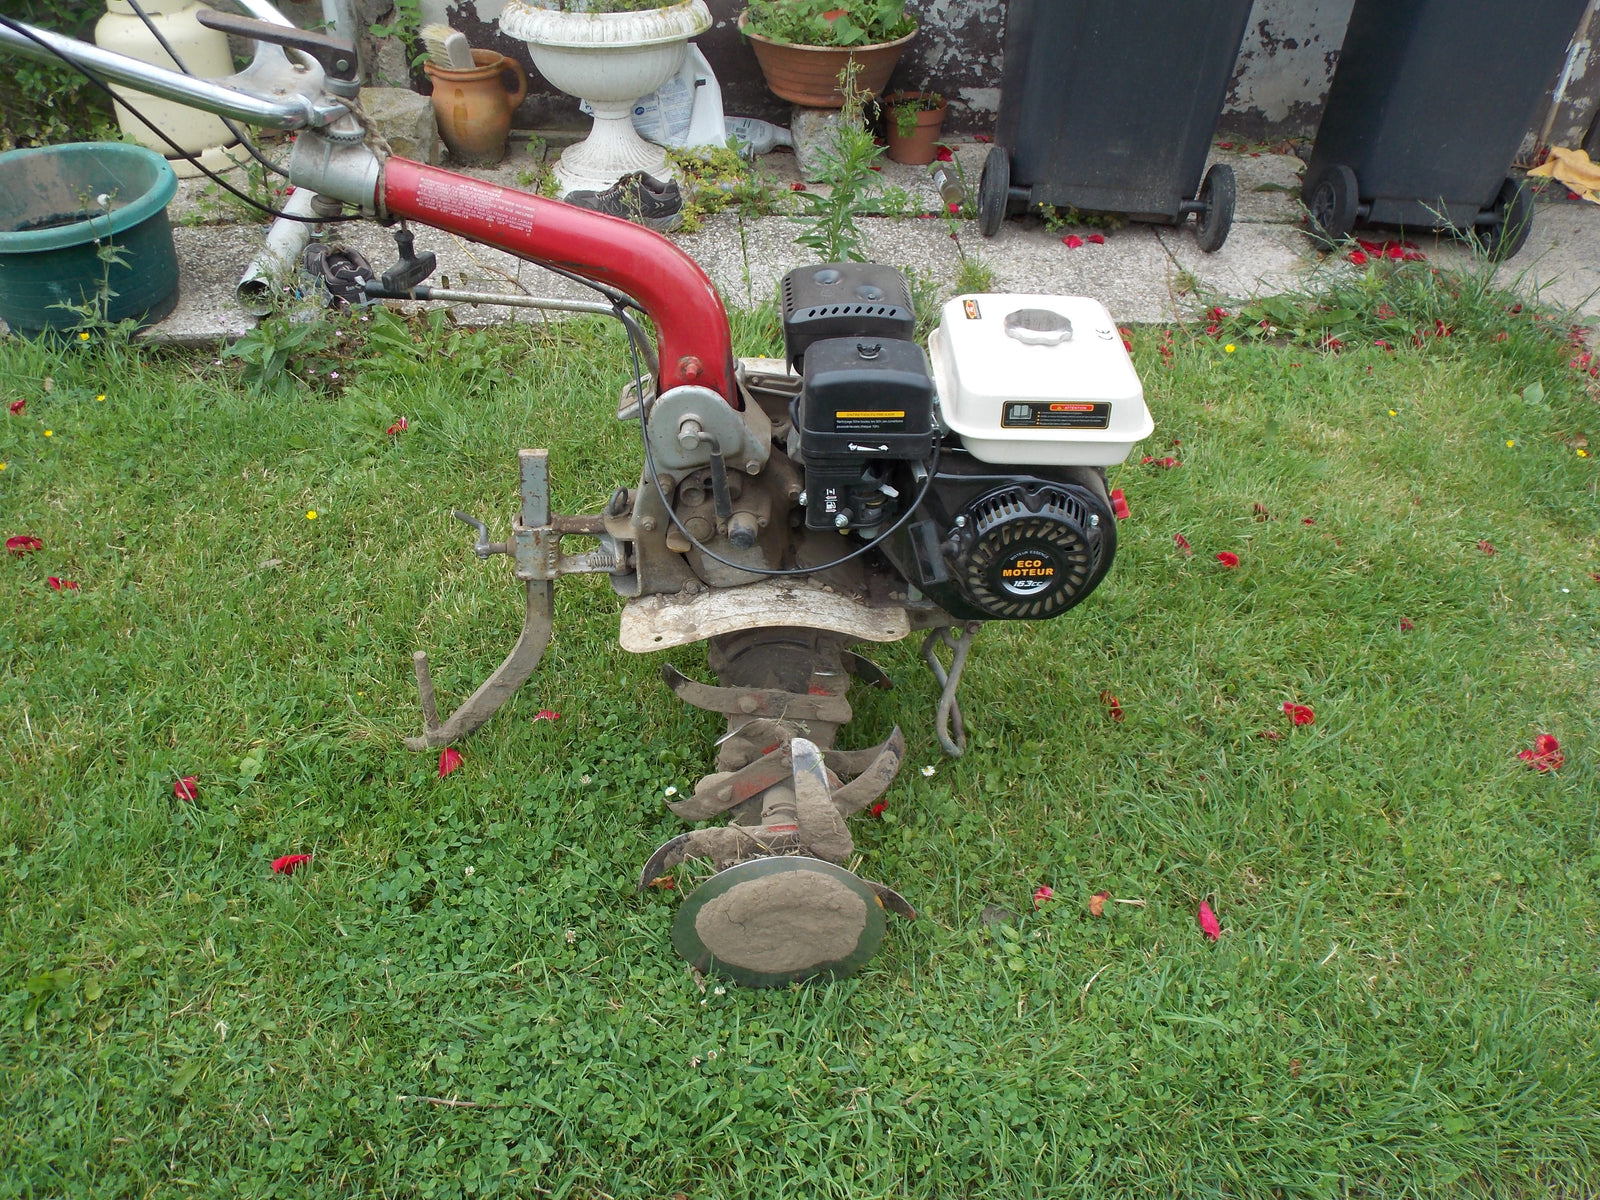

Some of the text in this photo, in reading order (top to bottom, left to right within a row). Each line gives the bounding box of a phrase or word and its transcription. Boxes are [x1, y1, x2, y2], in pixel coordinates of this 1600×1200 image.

[459, 184, 501, 198] ATTENTION
[1016, 560, 1042, 568] ECO
[1003, 568, 1054, 577] MOTEUR
